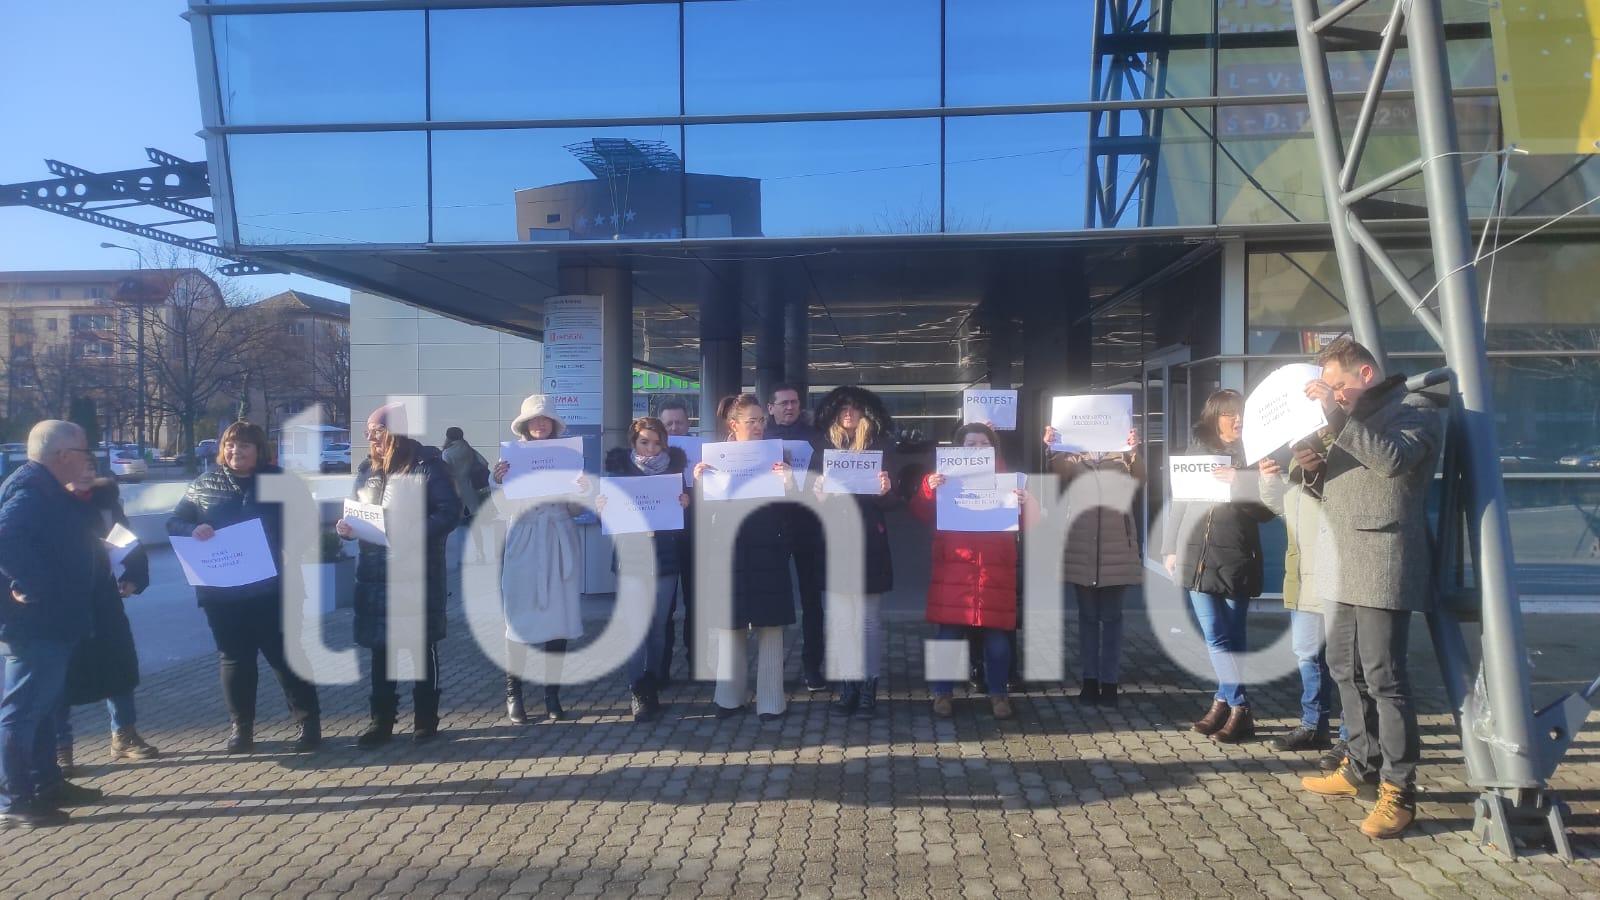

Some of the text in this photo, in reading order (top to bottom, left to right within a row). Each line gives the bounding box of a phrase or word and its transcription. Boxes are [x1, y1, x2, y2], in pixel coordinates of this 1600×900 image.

[966, 396, 1014, 405] PROTEST
[826, 460, 877, 470] PROTEST
[940, 456, 990, 467] PROTEST
[345, 506, 380, 520] PROTEST
